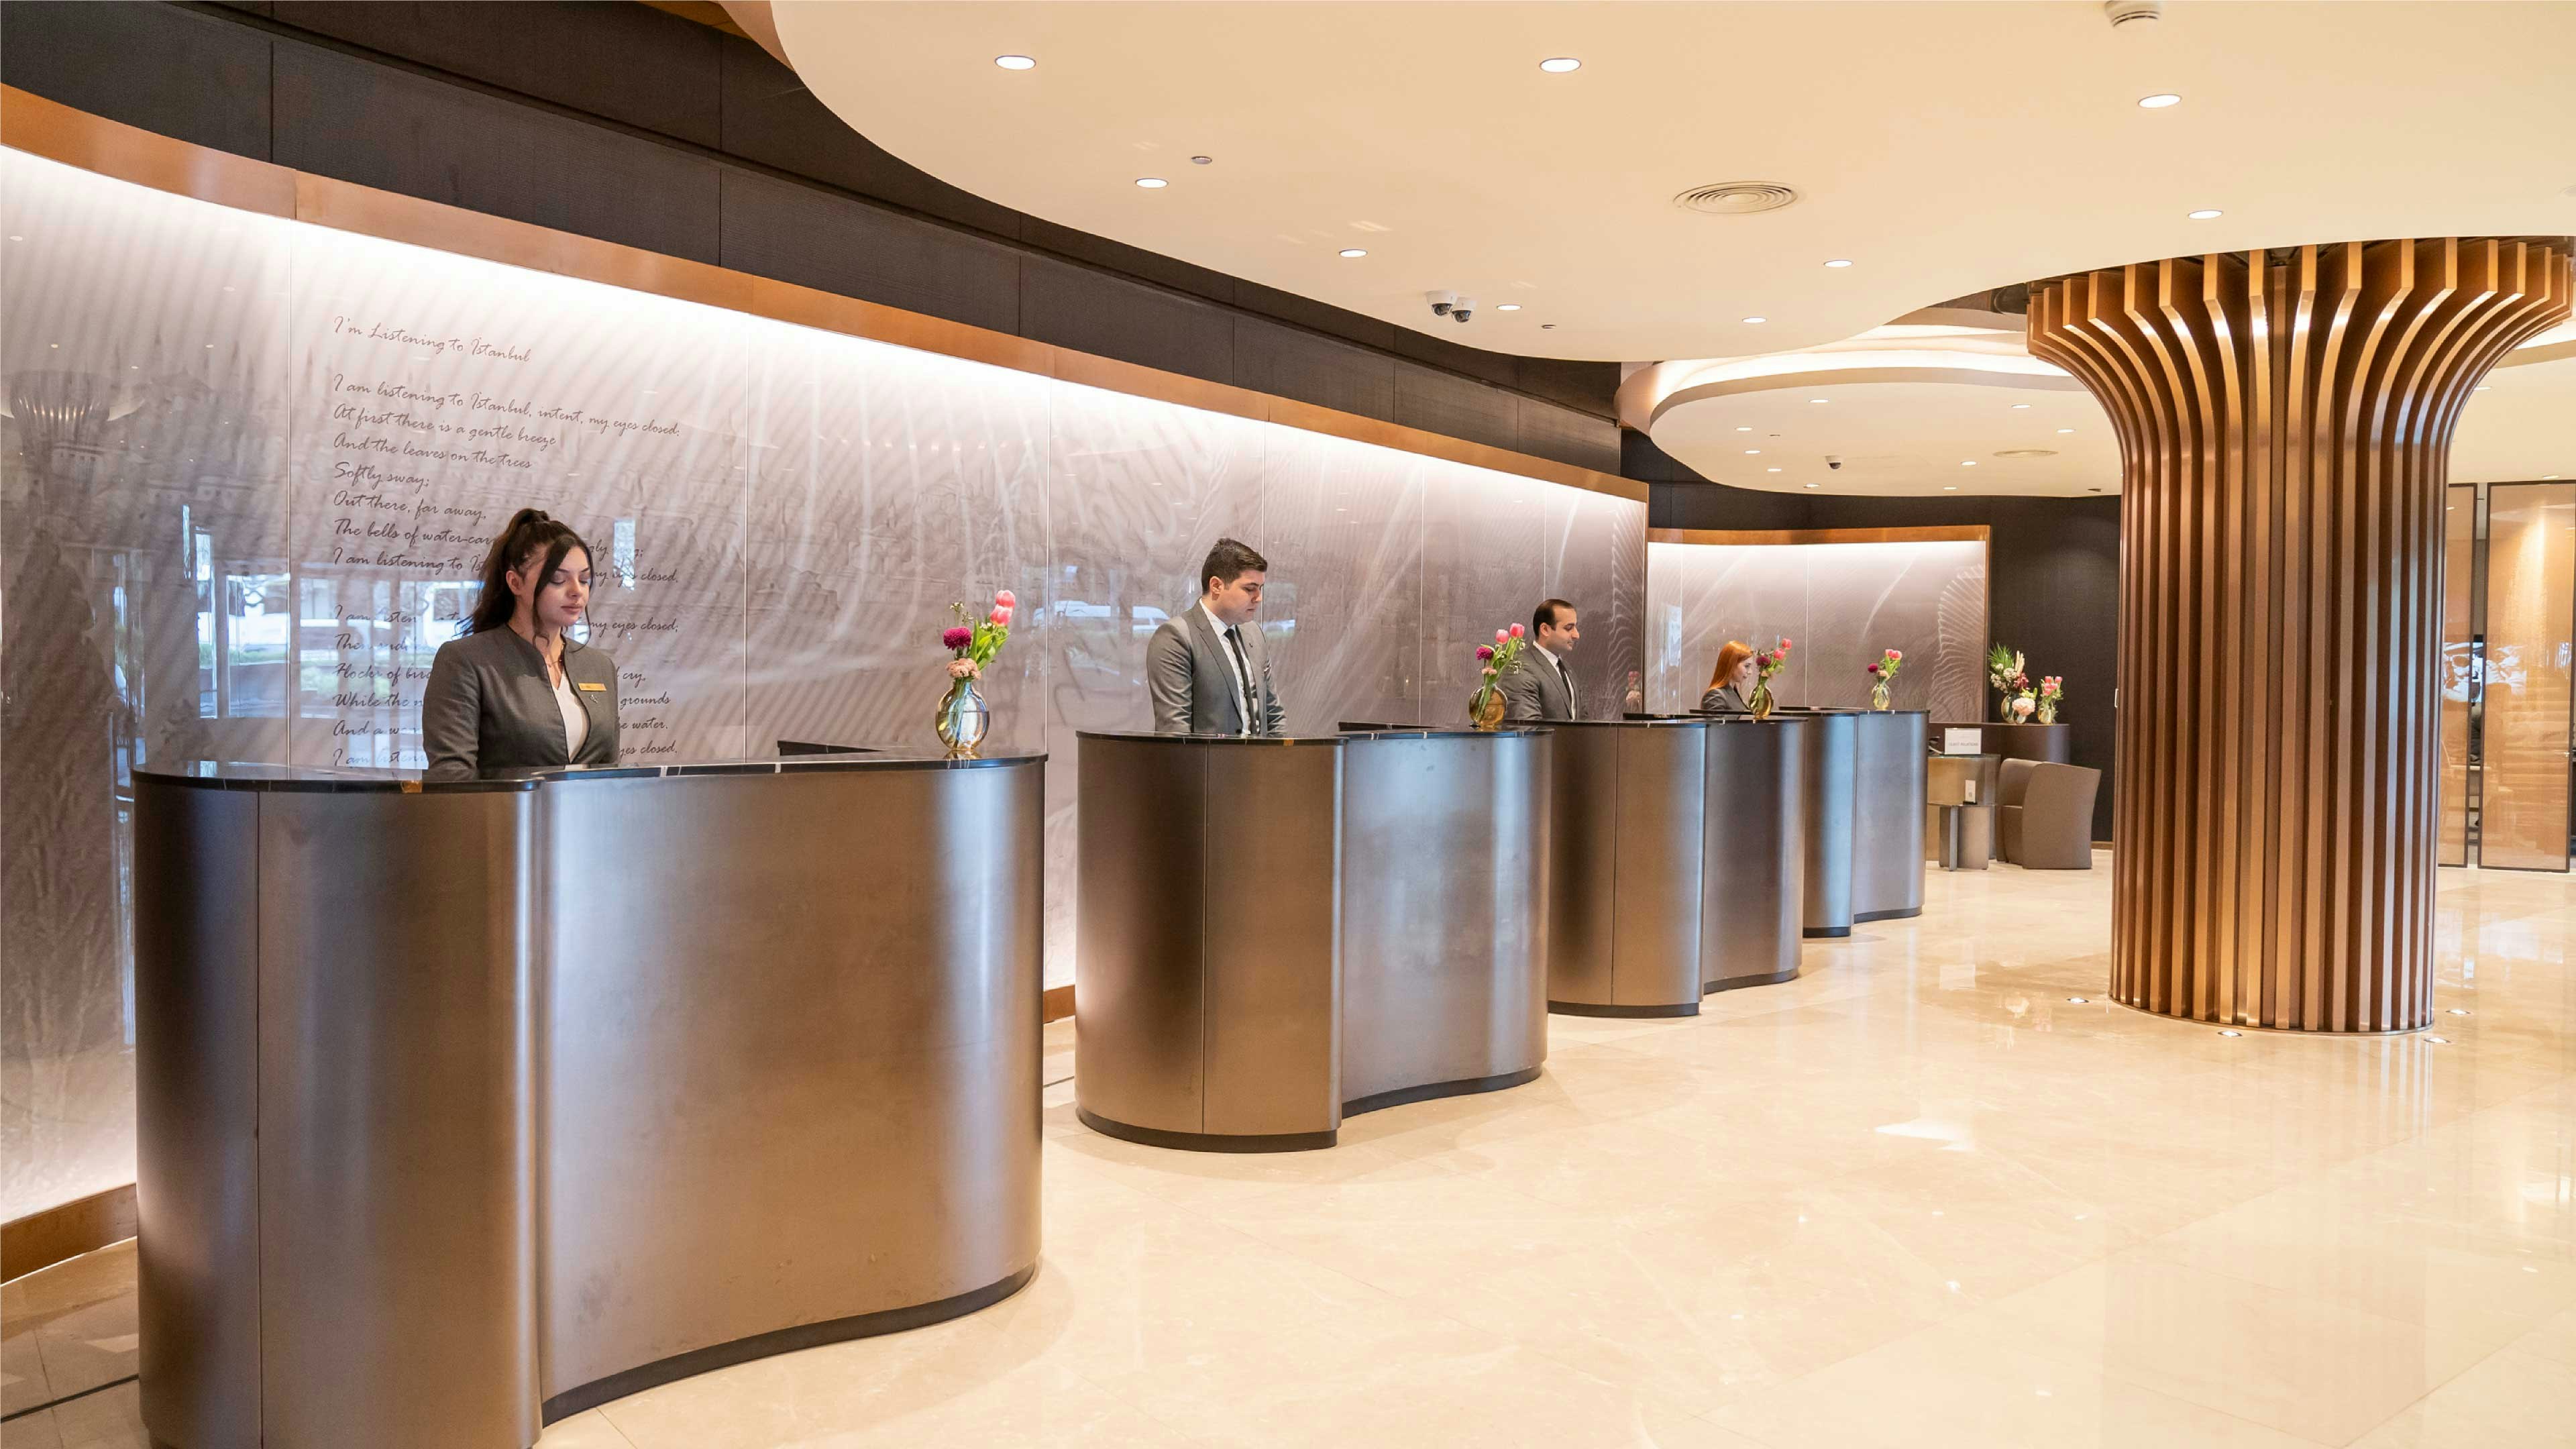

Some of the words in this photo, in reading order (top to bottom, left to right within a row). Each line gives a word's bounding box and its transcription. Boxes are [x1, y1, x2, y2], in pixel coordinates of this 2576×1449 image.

[334, 316, 362, 334] I'm
[368, 323, 445, 354] Listening
[448, 339, 464, 352] to
[334, 374, 343, 391] I
[346, 384, 371, 393] am
[377, 381, 445, 410] listening
[448, 393, 464, 407] to
[537, 407, 583, 424] intent,
[589, 417, 609, 433] my
[613, 420, 639, 436] eyes
[334, 403, 356, 421] At
[355, 408, 394, 429] first
[394, 413, 434, 430] there
[439, 421, 452, 432] is
[468, 425, 513, 441] gentle
[517, 427, 557, 451] breeze
[334, 432, 370, 449] And
[371, 438, 398, 454] the
[402, 441, 447, 459] leaves
[451, 451, 468, 462] on
[472, 450, 496, 464] the
[497, 458, 533, 469] trees
[334, 462, 384, 490] Softly
[333, 490, 366, 507] Out
[366, 494, 411, 513] there,
[414, 498, 439, 520] far
[444, 507, 486, 526] away,
[334, 519, 362, 536] The
[367, 521, 400, 539] bells
[405, 526, 419, 547] of
[423, 529, 494, 545] water-car
[333, 547, 343, 565] I
[345, 557, 370, 565] am
[376, 551, 444, 575] listening
[447, 557, 463, 570] to
[612, 622, 638, 637] eyes
[386, 665, 402, 686] of
[332, 692, 381, 707] While
[384, 692, 409, 706] the
[619, 692, 671, 710] grounds
[333, 719, 370, 736] And
[632, 717, 668, 729] water.
[619, 746, 637, 761] yes
